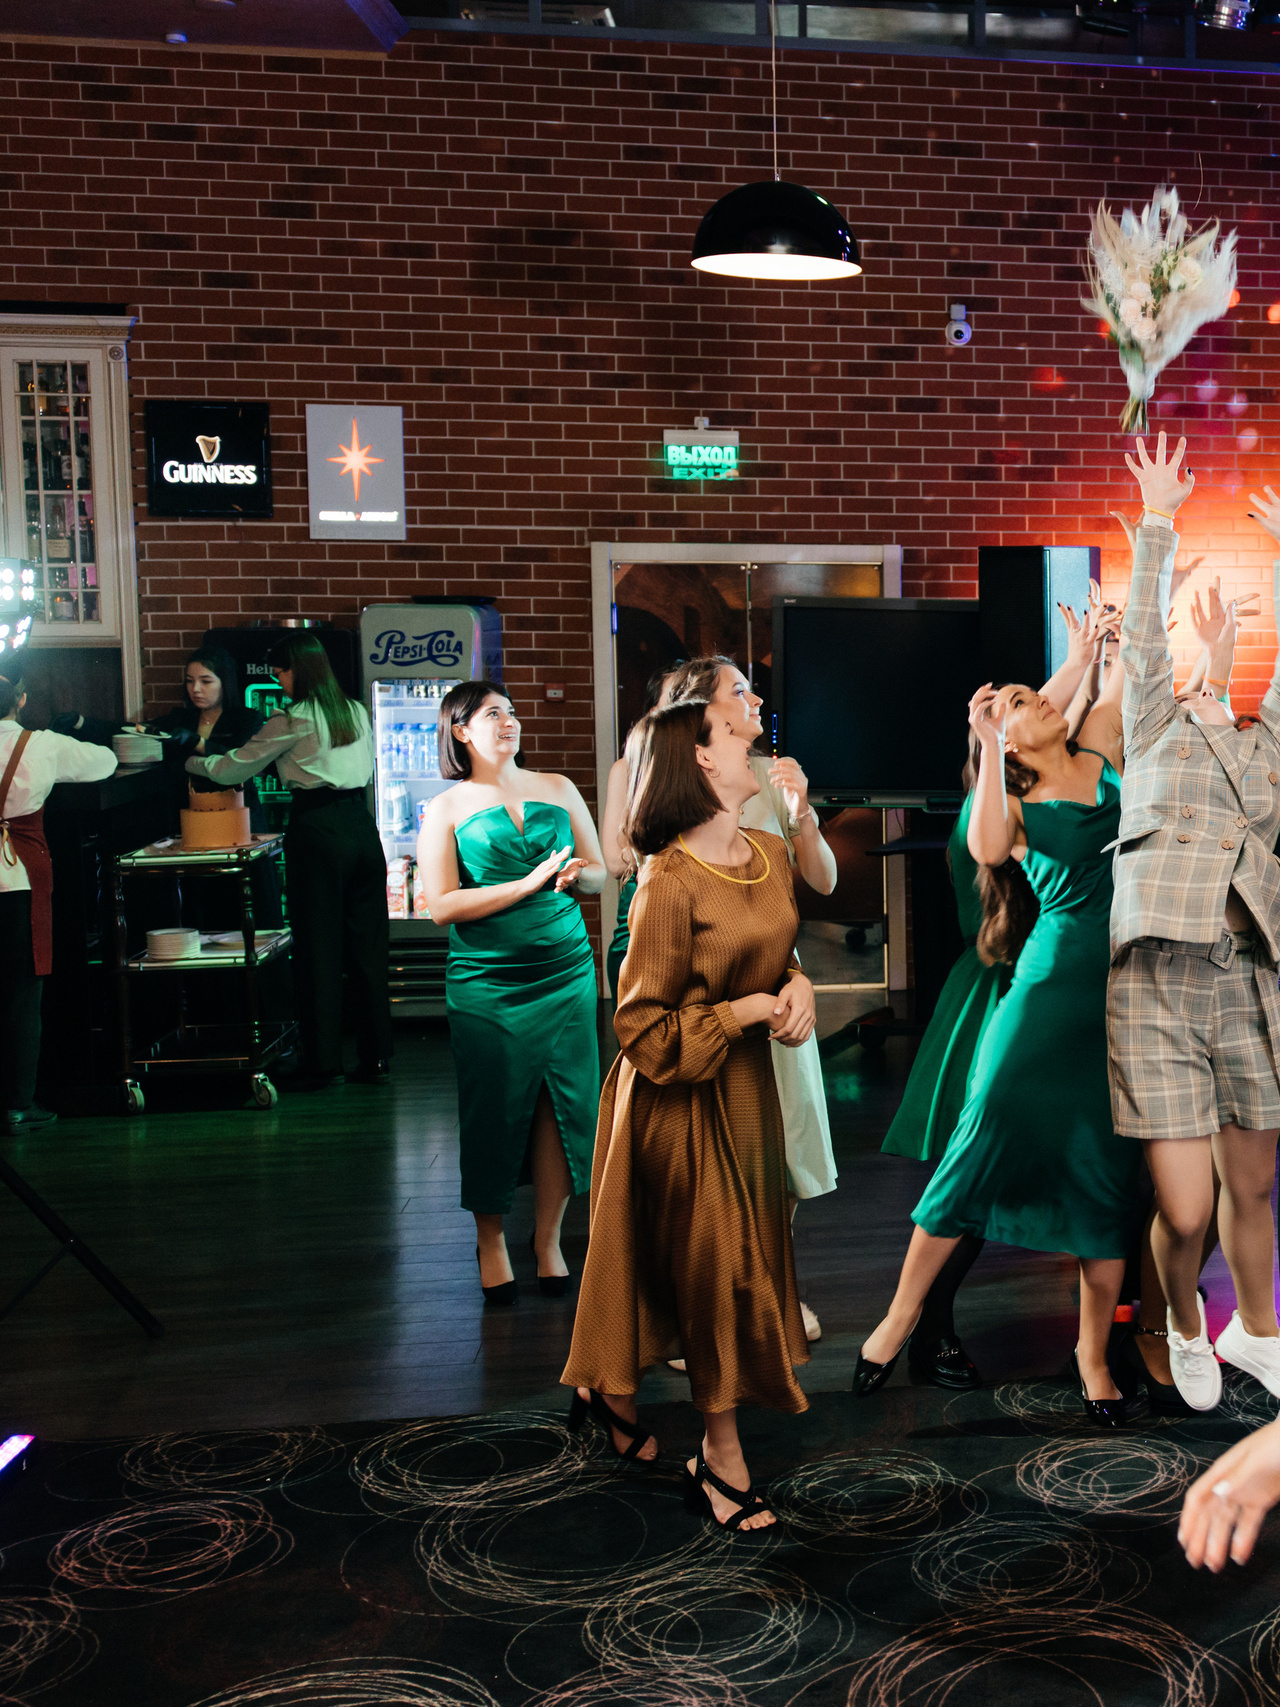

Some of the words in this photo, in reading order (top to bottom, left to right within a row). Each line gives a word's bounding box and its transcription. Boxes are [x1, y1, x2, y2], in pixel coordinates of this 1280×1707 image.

[667, 445, 737, 469] ВЫХОД
[163, 460, 257, 485] GUINNESS
[673, 467, 730, 480] EXIT
